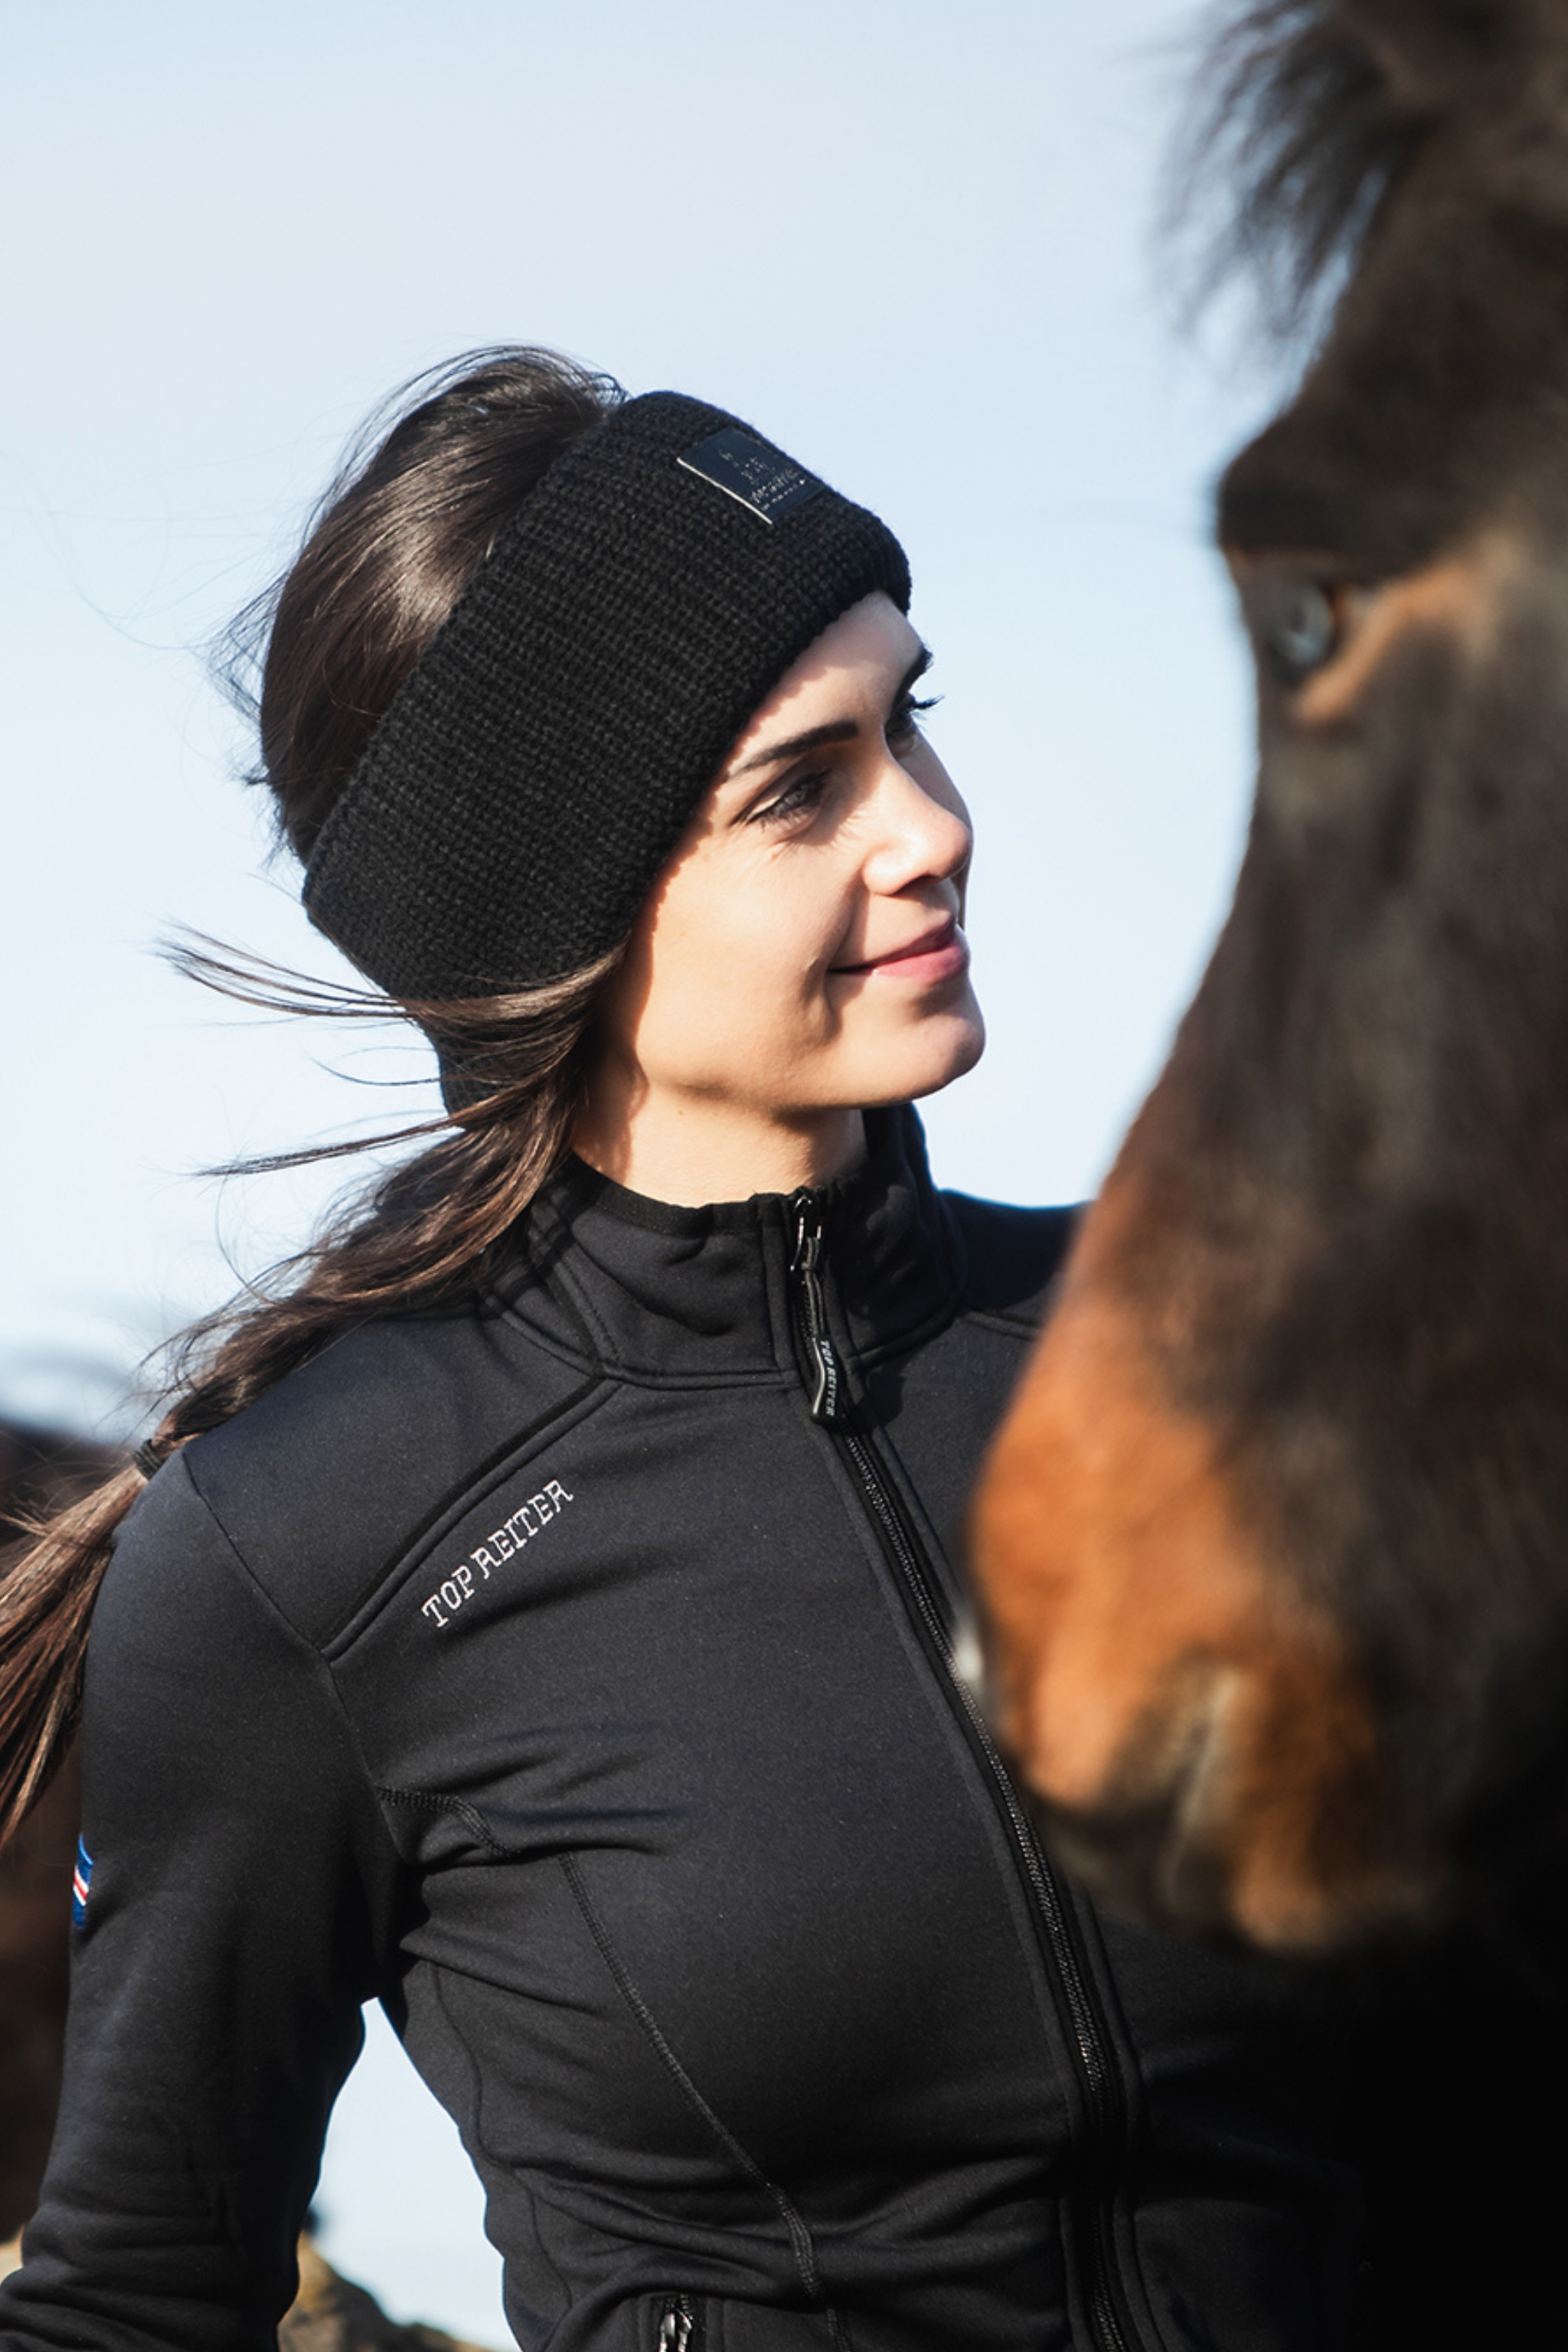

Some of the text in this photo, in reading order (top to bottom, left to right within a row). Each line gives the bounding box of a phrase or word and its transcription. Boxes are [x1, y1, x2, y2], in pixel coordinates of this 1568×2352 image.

[820, 1340, 838, 1416] TOP REITER
[421, 1479, 574, 1628] TOP REITER
